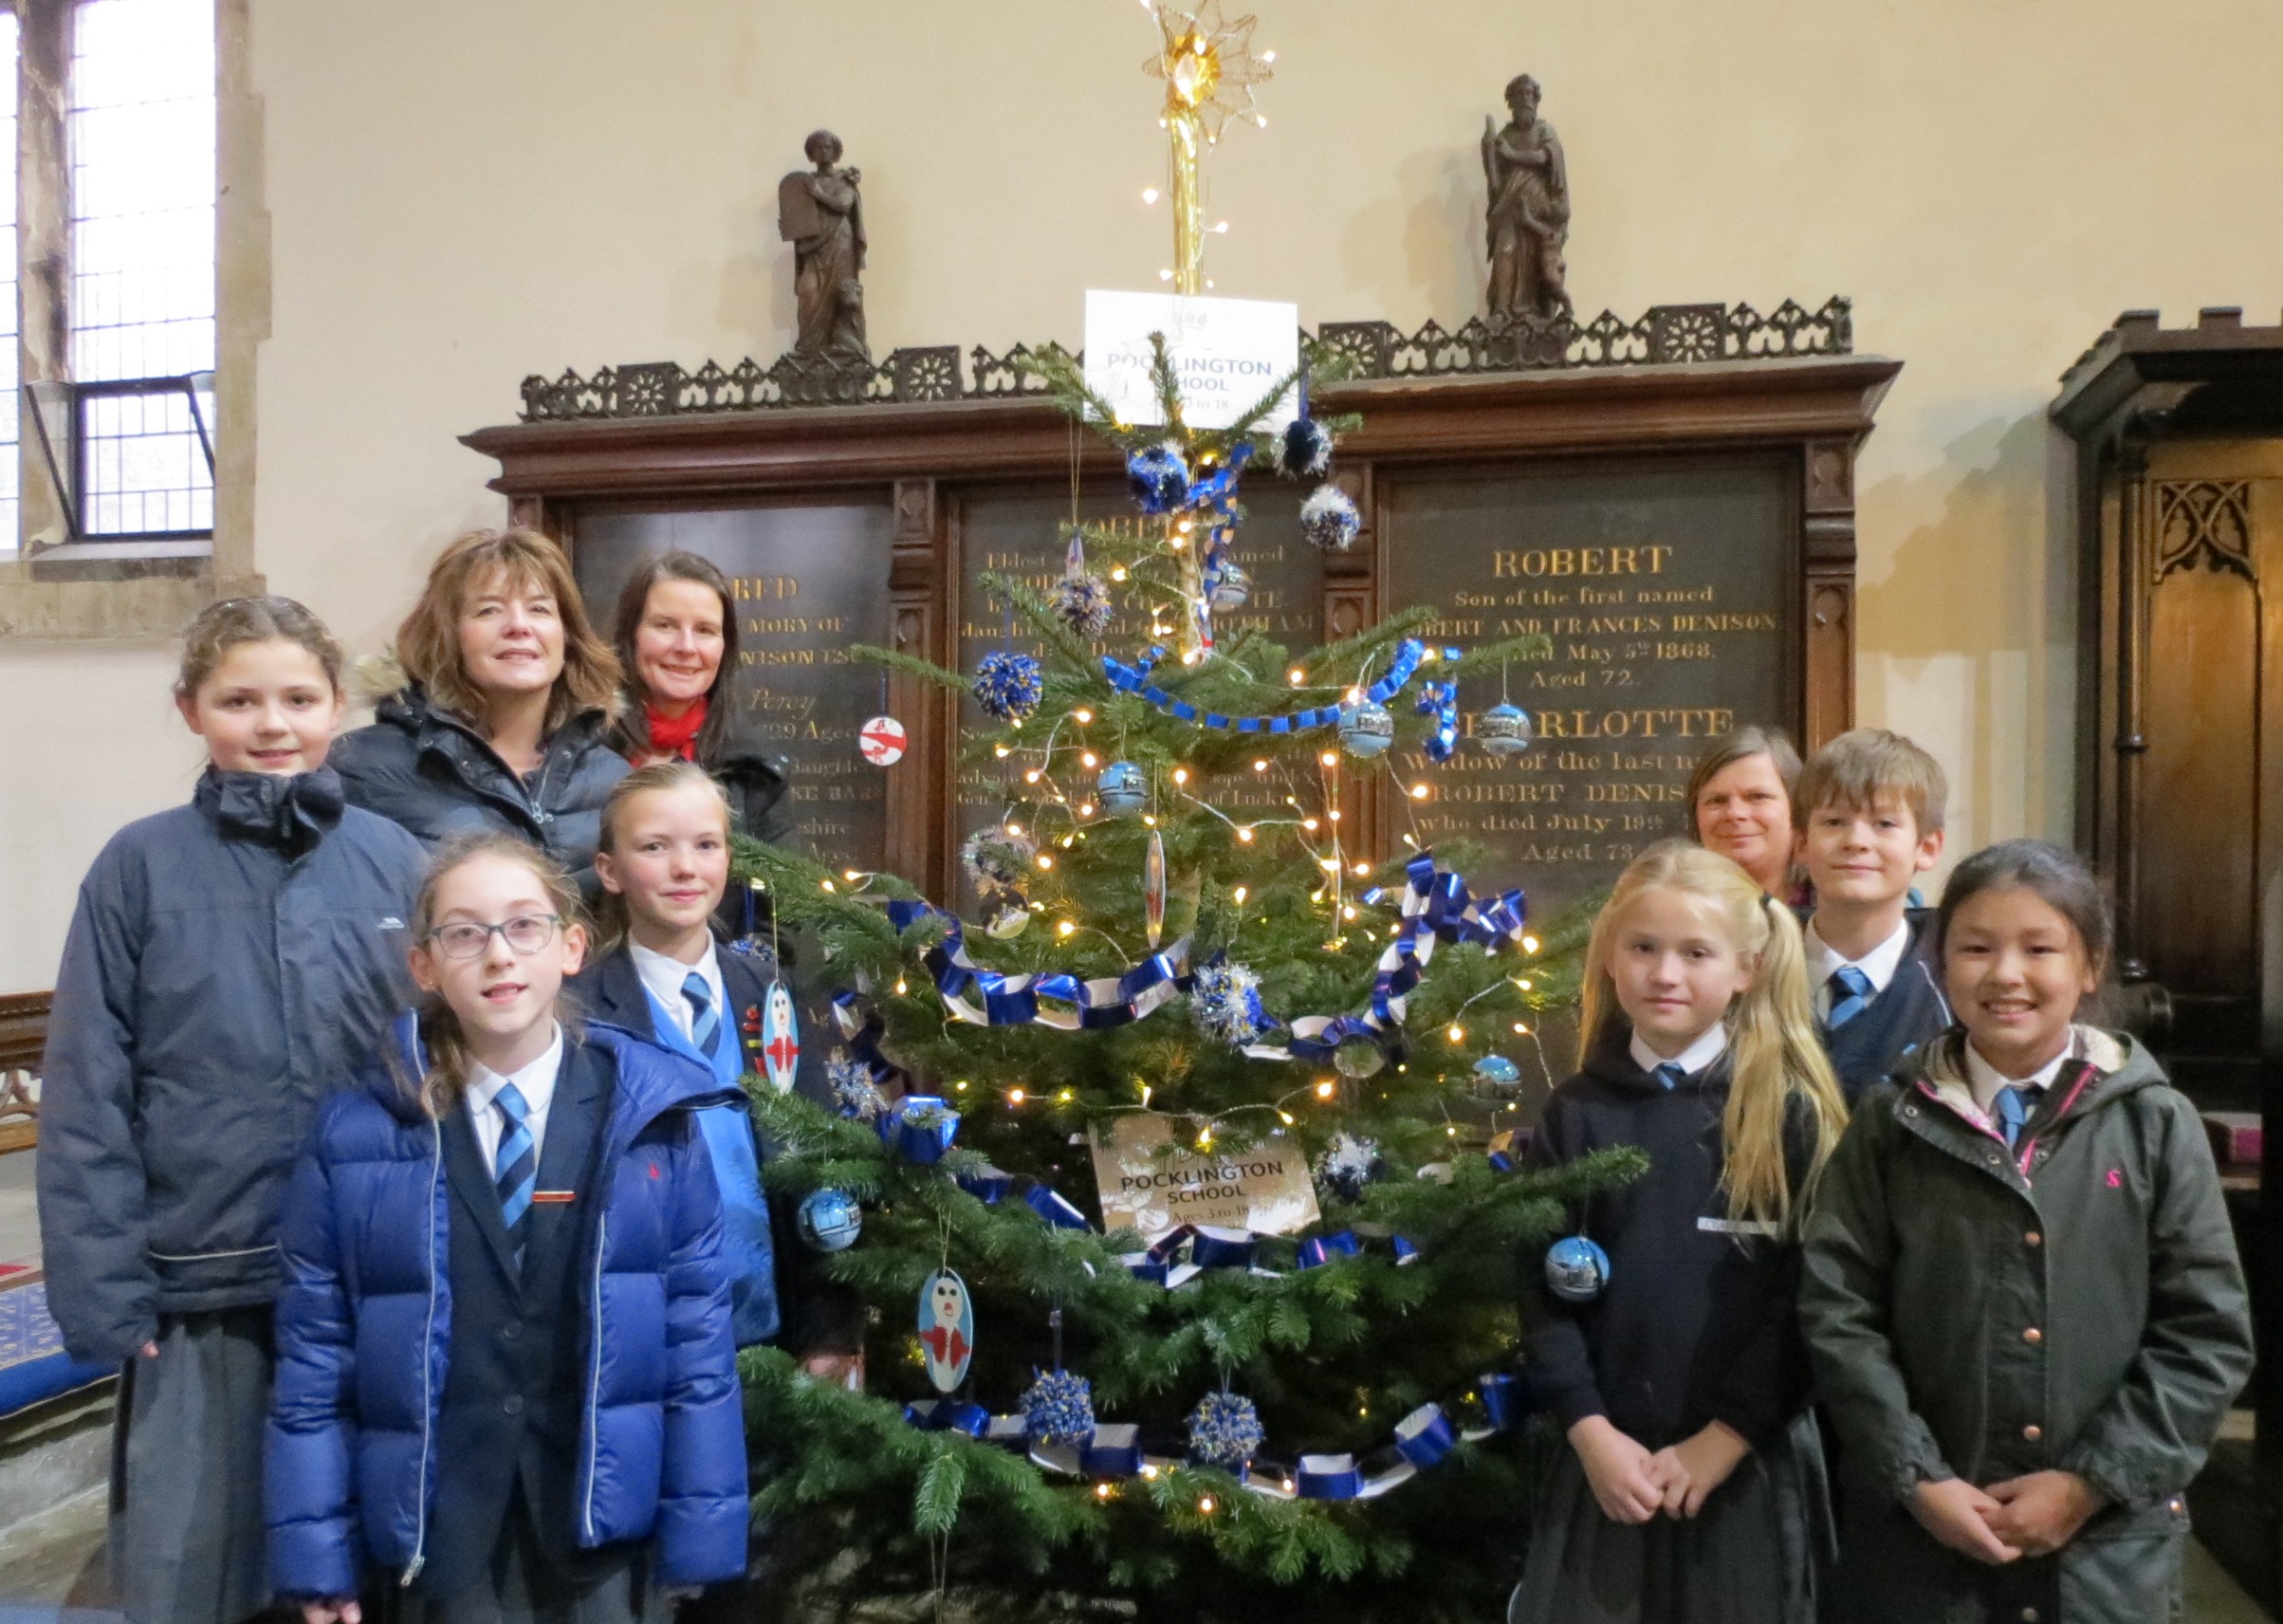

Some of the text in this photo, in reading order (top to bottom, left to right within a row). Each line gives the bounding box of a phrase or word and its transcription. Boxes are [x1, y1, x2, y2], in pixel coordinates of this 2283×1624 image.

[1493, 546, 1672, 578] ROBERT
[1455, 584, 1714, 607] Son of the first named
[1497, 618, 1543, 636] AND
[1552, 616, 1662, 635] FRANCES
[1672, 613, 1778, 633] DENISON
[1567, 642, 1611, 664] May
[1529, 670, 1587, 690] Aged
[1519, 751, 1547, 770] of
[1557, 750, 1601, 770] the
[1612, 750, 1664, 770] last
[1585, 782, 1685, 803] DENIS
[1419, 813, 1470, 831] who
[1481, 813, 1537, 831] died
[1546, 813, 1613, 835] July
[1520, 842, 1593, 862] Aged
[1120, 1159, 1284, 1190] POCKLINGTON
[1168, 1184, 1246, 1205] SCHOOL
